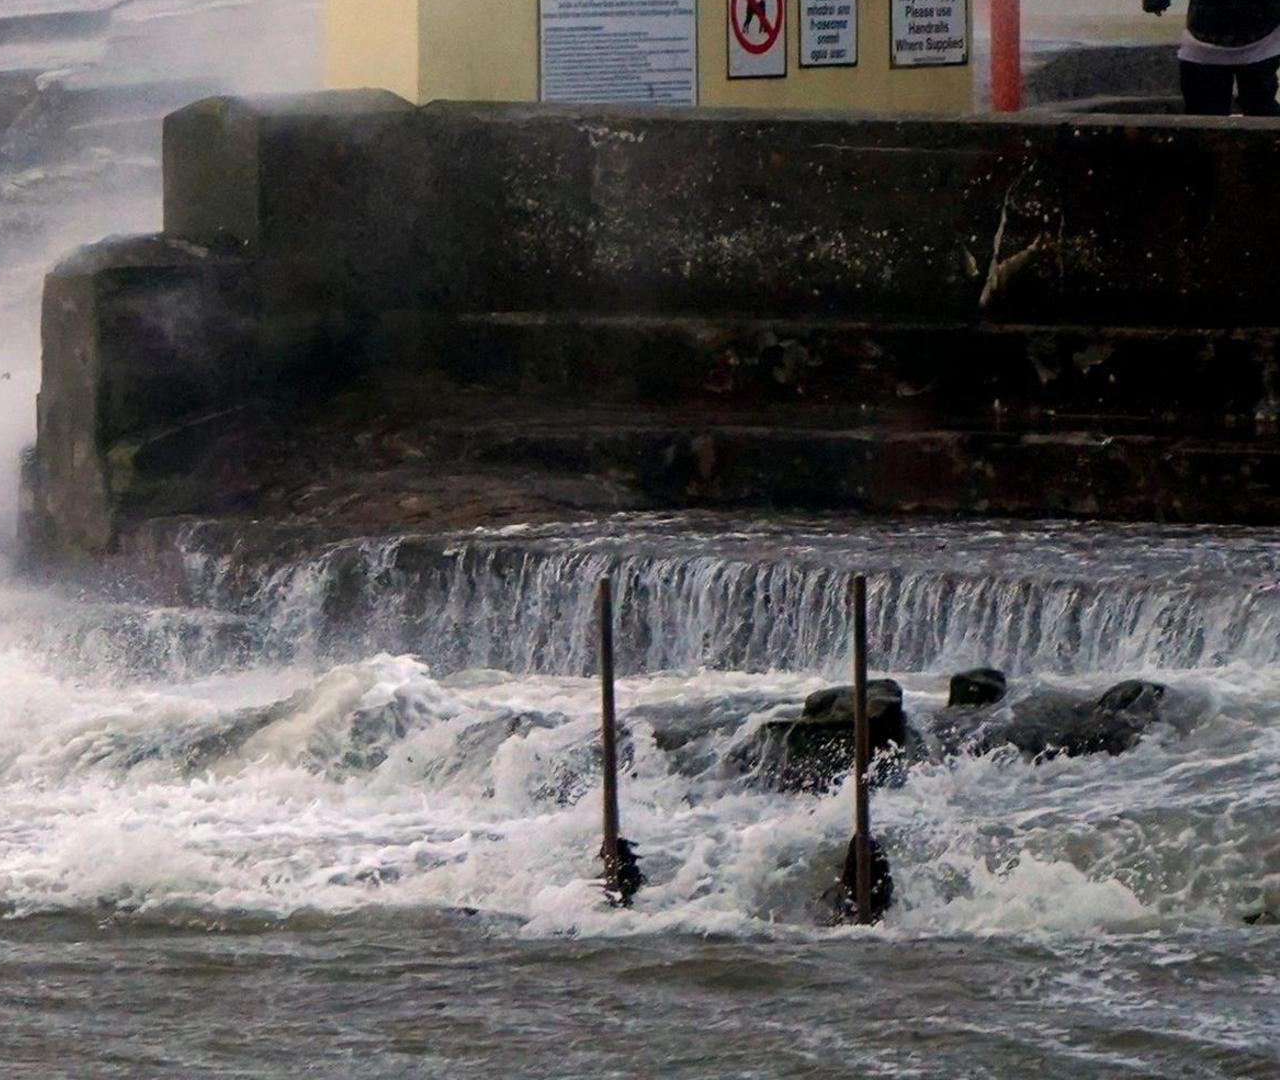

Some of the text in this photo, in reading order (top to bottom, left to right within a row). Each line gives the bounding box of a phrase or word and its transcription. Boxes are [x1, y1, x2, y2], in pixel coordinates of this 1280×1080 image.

[905, 5, 952, 17] Please use
[908, 20, 949, 34] Handrails
[896, 37, 964, 52] Where Supplied
